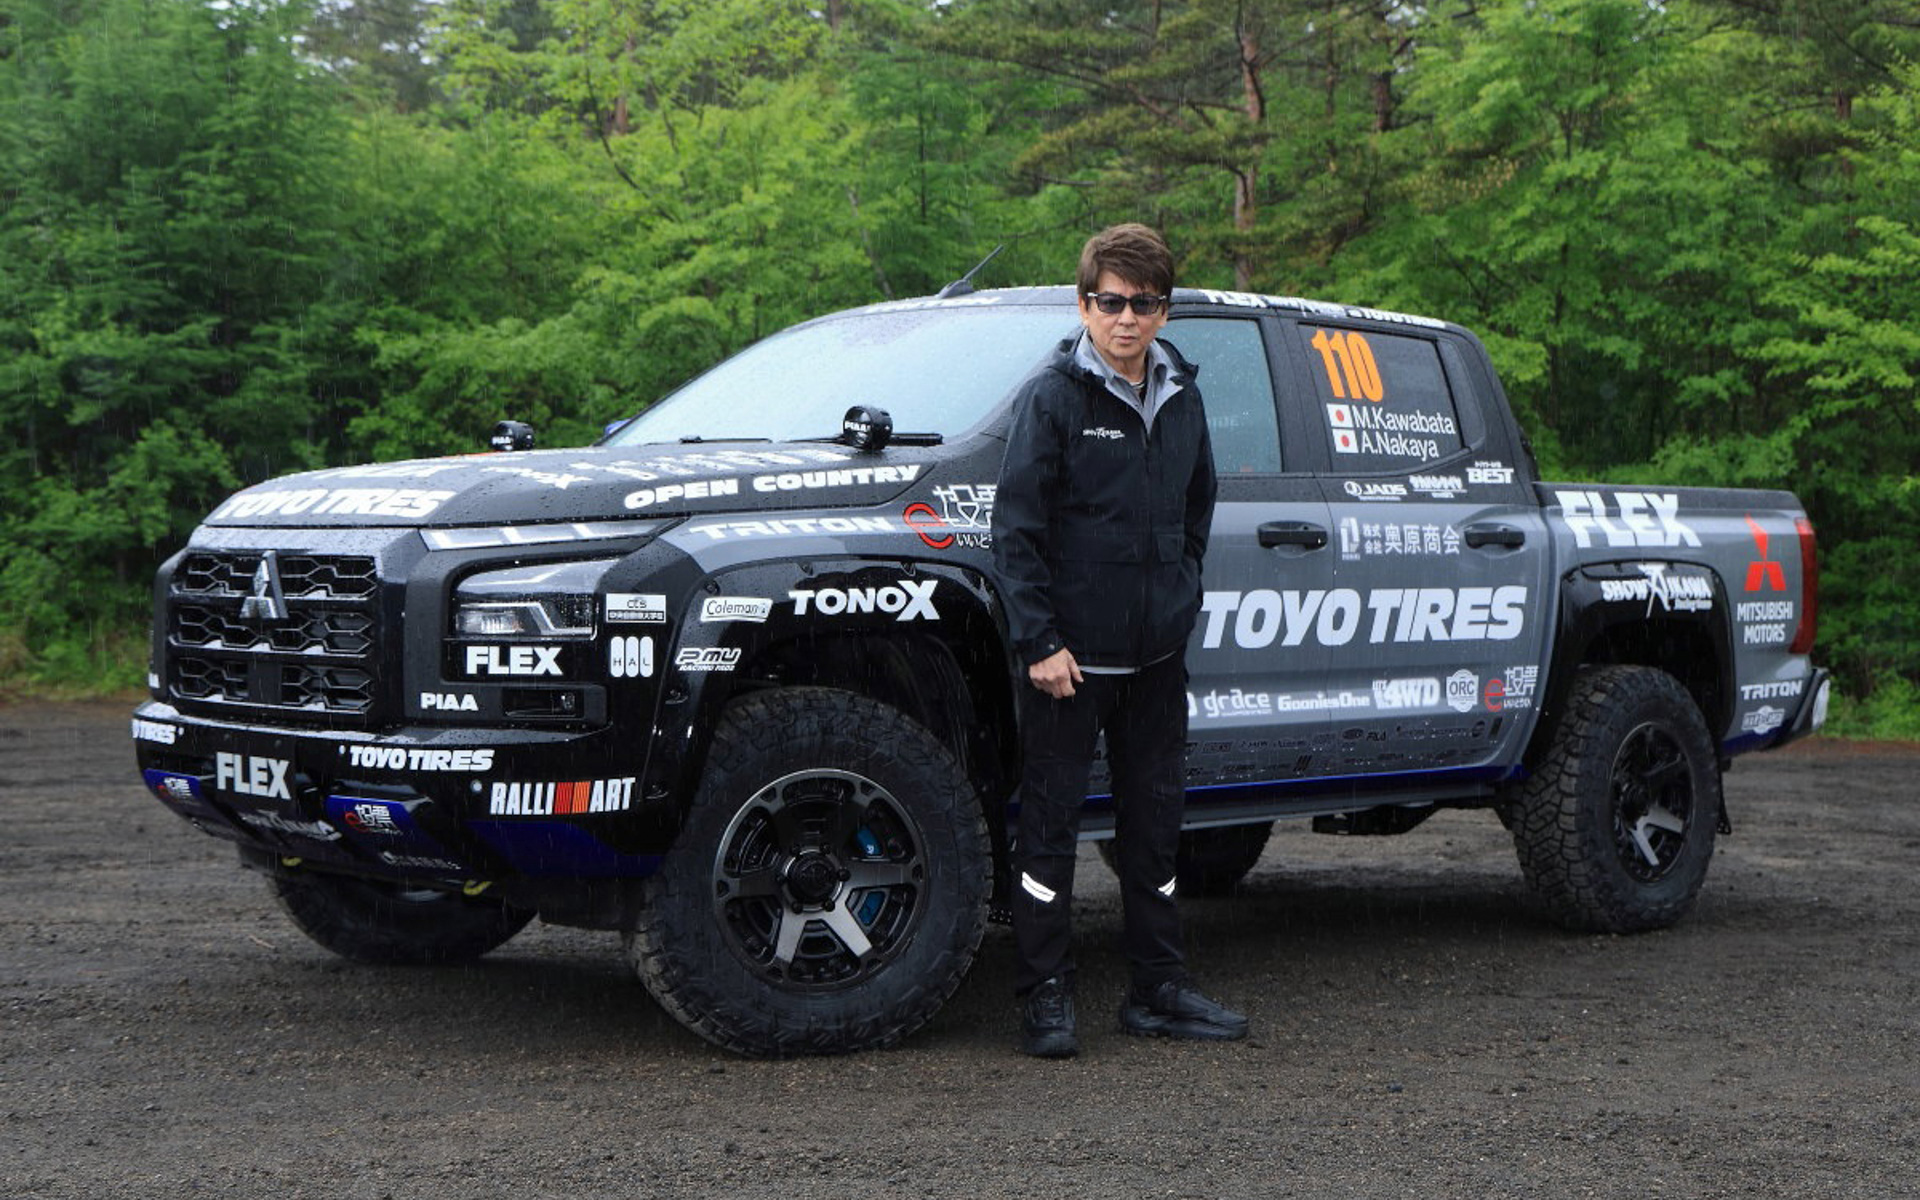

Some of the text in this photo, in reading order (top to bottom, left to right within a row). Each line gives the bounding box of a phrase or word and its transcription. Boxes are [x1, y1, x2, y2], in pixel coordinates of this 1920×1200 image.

[1311, 329, 1383, 403] 110
[1352, 405, 1456, 435] M.Kawabata
[1361, 430, 1440, 462] A.Nakaya
[624, 478, 740, 510] OPEN
[753, 464, 921, 492] COUNTRY
[1466, 467, 1515, 485] BEST
[215, 488, 458, 519] TOYO TIRES
[689, 516, 898, 540] TRITON
[1555, 490, 1703, 549] FLEX
[1385, 523, 1461, 556] 奥原商会
[706, 600, 758, 616] Coleman
[788, 580, 941, 621] TONOX
[1736, 600, 1795, 622] MITSUBISHI
[1202, 586, 1528, 649] TOYO TIRES
[1743, 624, 1786, 645] MOTORS
[465, 645, 564, 675] FLEX
[421, 692, 479, 712] PIAA
[1450, 680, 1476, 696] ORC
[1740, 680, 1803, 701] TRITON
[350, 744, 495, 772] TOYO TIRES
[215, 751, 291, 800] FLEX
[490, 776, 637, 816] RALLI ART
